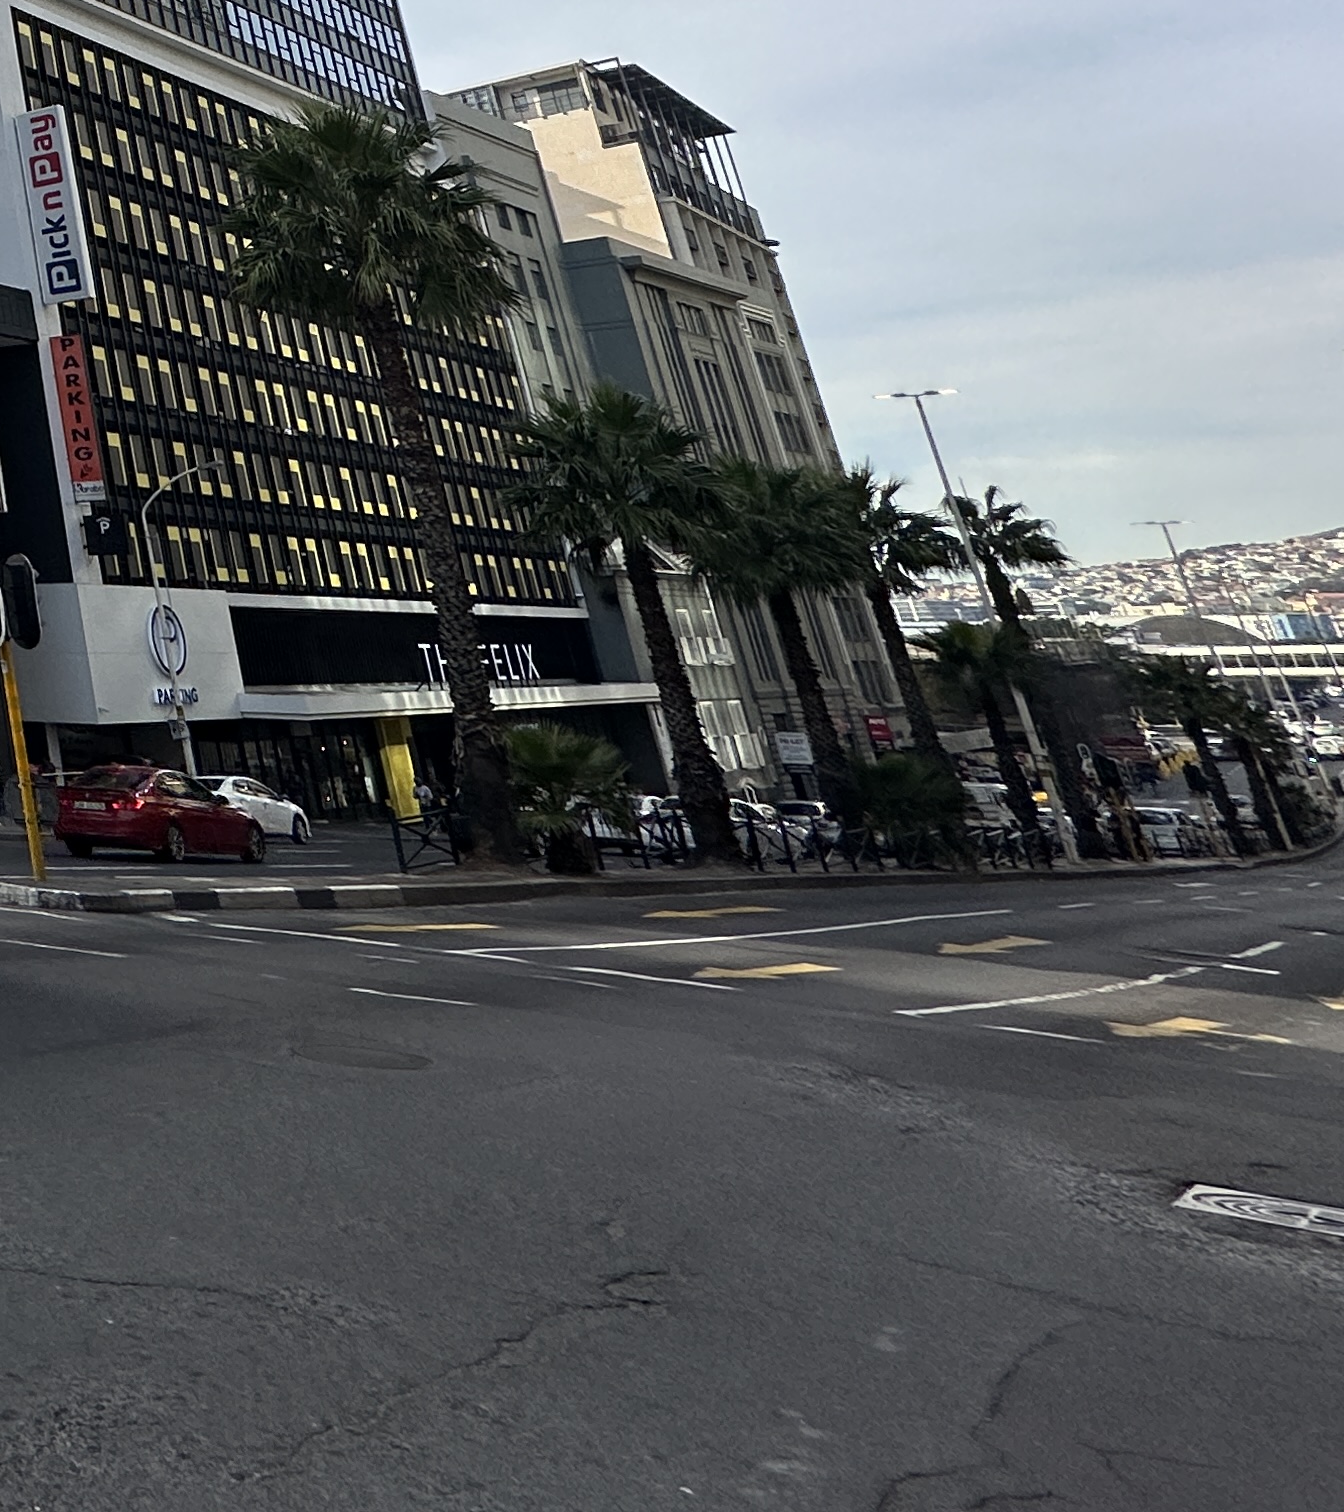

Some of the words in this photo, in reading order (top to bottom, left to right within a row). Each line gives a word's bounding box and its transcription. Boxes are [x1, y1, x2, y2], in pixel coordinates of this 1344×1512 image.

[29, 113, 63, 188] Pay
[43, 190, 63, 210] n
[42, 214, 81, 295] Pick
[60, 338, 94, 461] PARKING
[418, 644, 448, 683] TH
[157, 688, 199, 704] PARING
